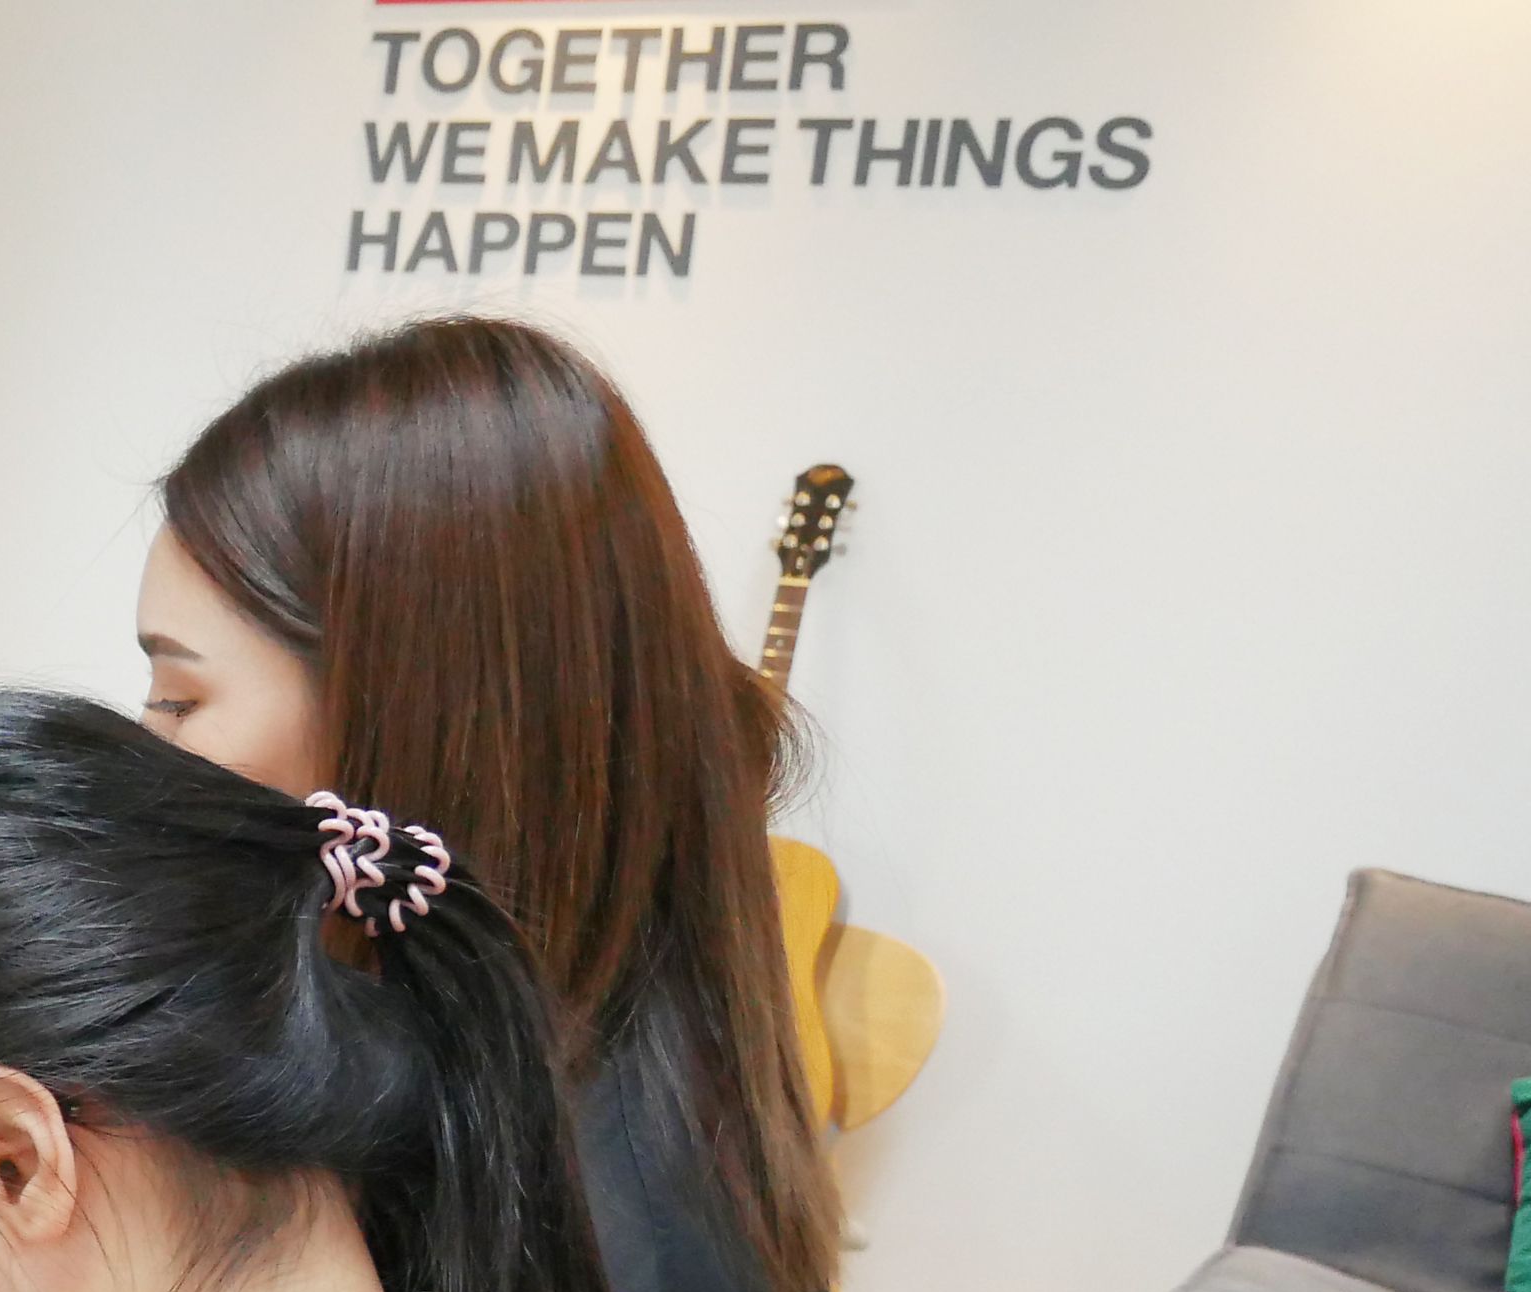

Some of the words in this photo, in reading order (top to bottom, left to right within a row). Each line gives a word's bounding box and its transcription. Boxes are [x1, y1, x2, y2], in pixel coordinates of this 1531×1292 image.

[372, 23, 850, 95] TOGETHER
[365, 120, 490, 185] WE
[506, 117, 775, 185] MAKE
[797, 115, 1154, 192] THINGS
[346, 210, 697, 278] HAPPEN
